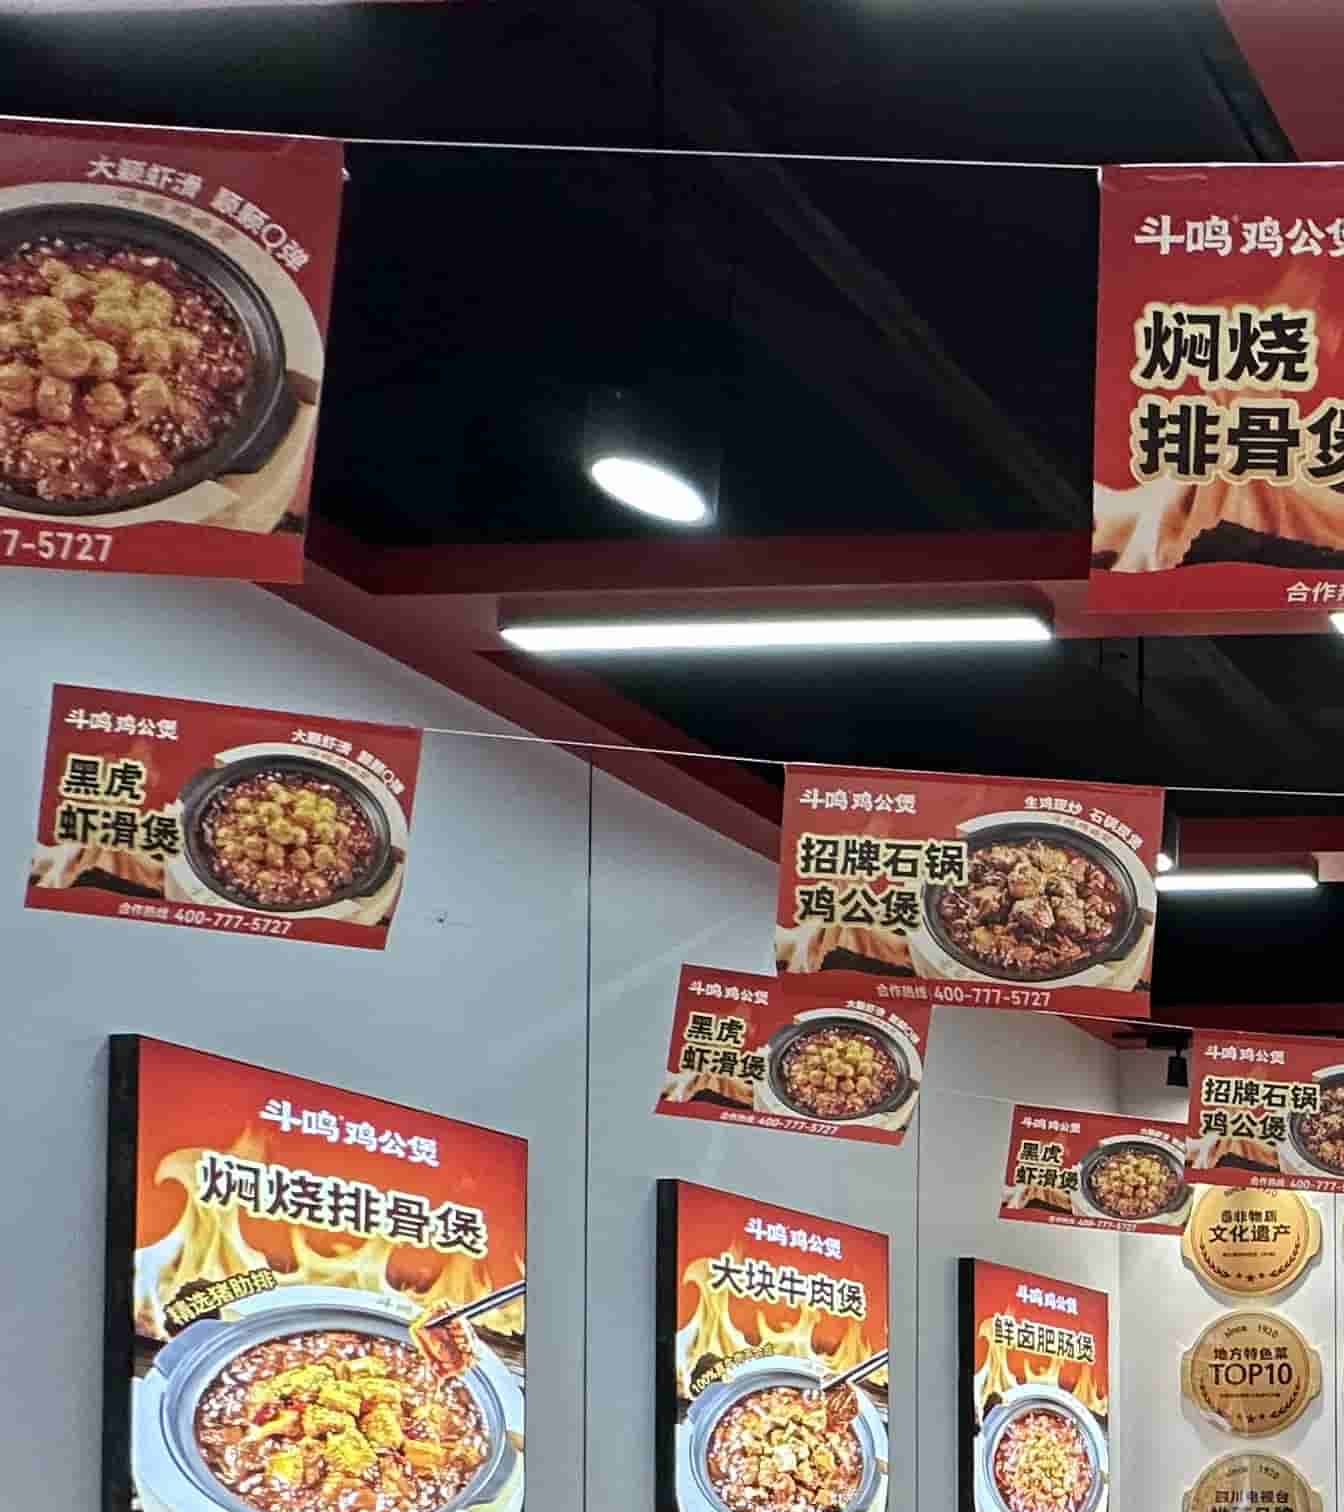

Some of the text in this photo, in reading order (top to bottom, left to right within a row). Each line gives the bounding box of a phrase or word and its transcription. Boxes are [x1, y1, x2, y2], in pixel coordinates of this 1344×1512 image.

[1142, 309, 1309, 384] 焖烧
[63, 758, 144, 800] 黑虎
[58, 804, 181, 855] 虾滑煲
[800, 837, 965, 881] 招牌石锅
[174, 908, 292, 935] 400-777-5727
[799, 885, 921, 929] 鸡公煲
[934, 987, 1051, 1007] 400-777-5727
[686, 1014, 744, 1044] 黑虎
[682, 1046, 764, 1081] 虾滑煲
[1205, 1079, 1318, 1109] 招牌石锅
[260, 1098, 440, 1168] 斗鸣鸡公煲
[1203, 1112, 1285, 1141] 鸡公煲
[1016, 1167, 1078, 1191] 虾滑煲
[201, 1153, 488, 1255] 焖烧排骨煲
[1209, 1224, 1290, 1243] 文化遗产
[711, 1257, 864, 1317] 大块牛肉煲
[993, 1315, 1095, 1363] 鲜卤肥肠煲
[1208, 1362, 1293, 1387] TOP10
